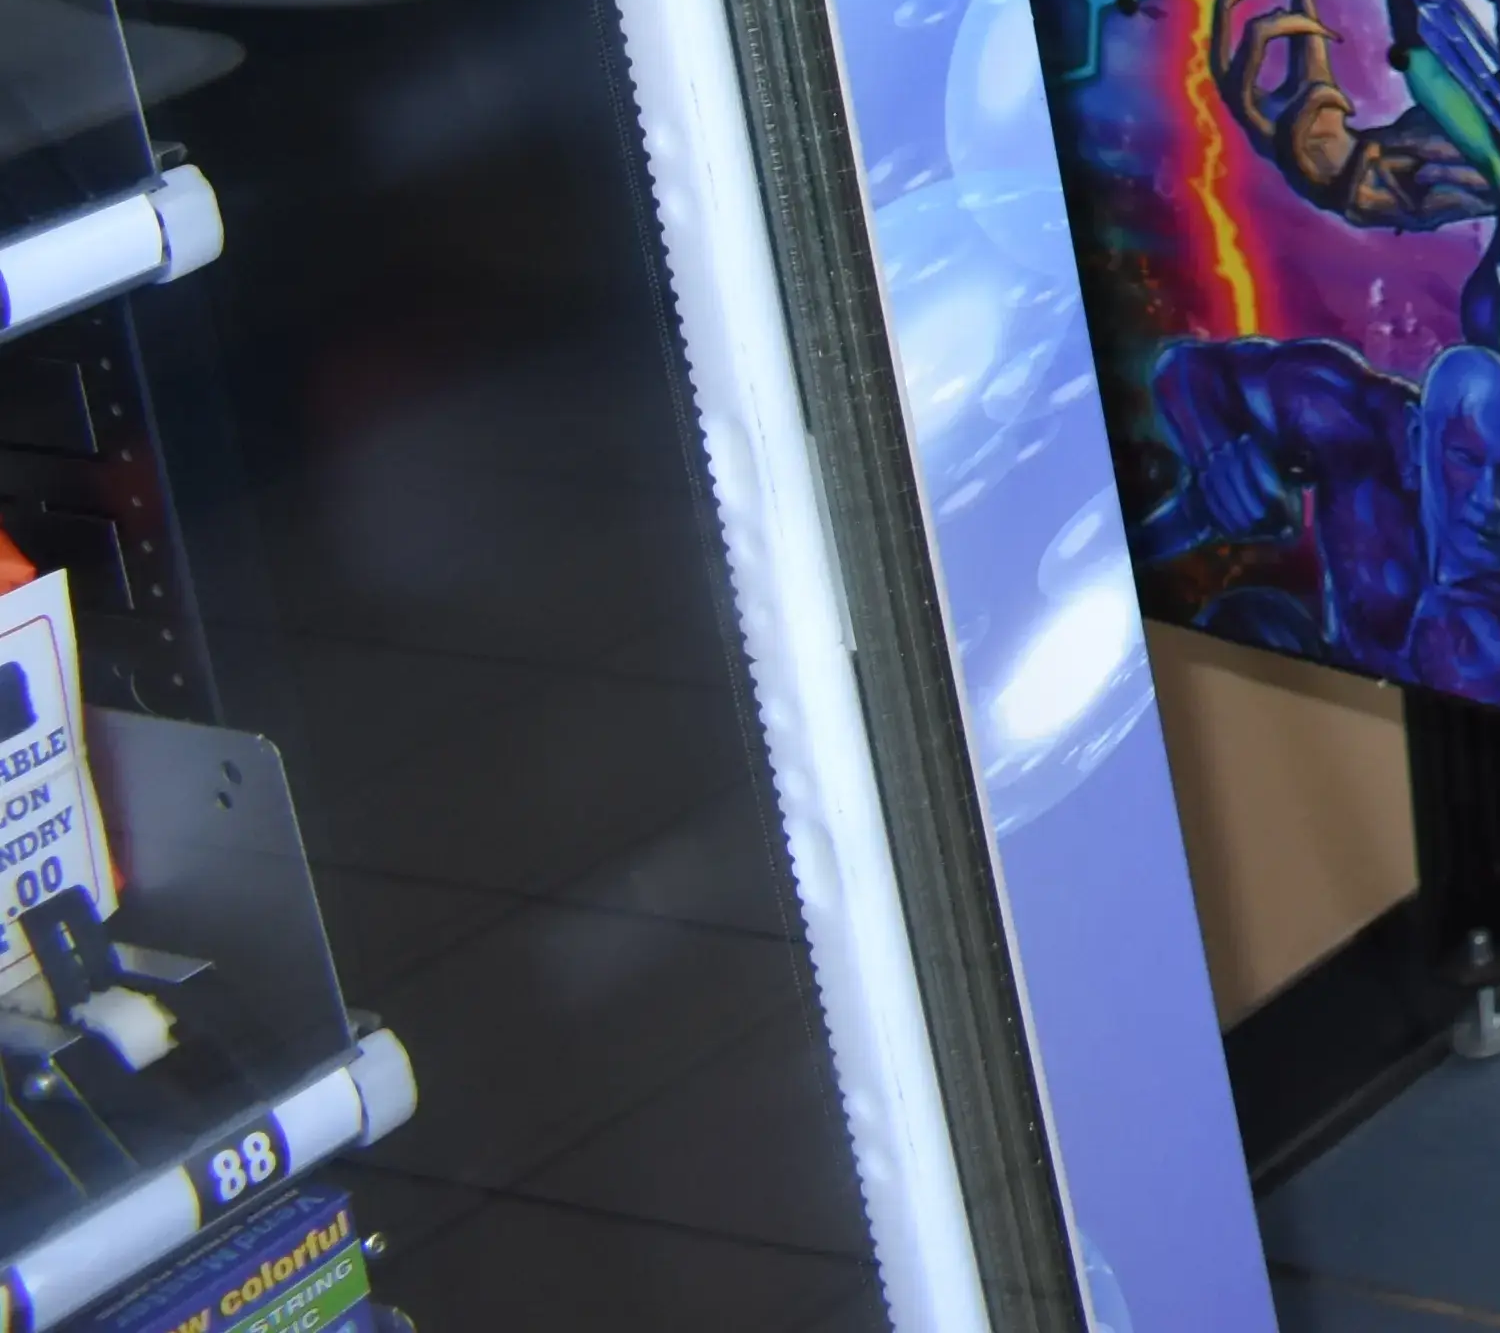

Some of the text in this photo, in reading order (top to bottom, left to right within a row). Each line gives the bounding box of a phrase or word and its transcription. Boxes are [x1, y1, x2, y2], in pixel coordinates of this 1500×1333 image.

[212, 1131, 277, 1200] 88
[219, 1209, 349, 1317] colorful
[249, 1257, 353, 1333] STRING
